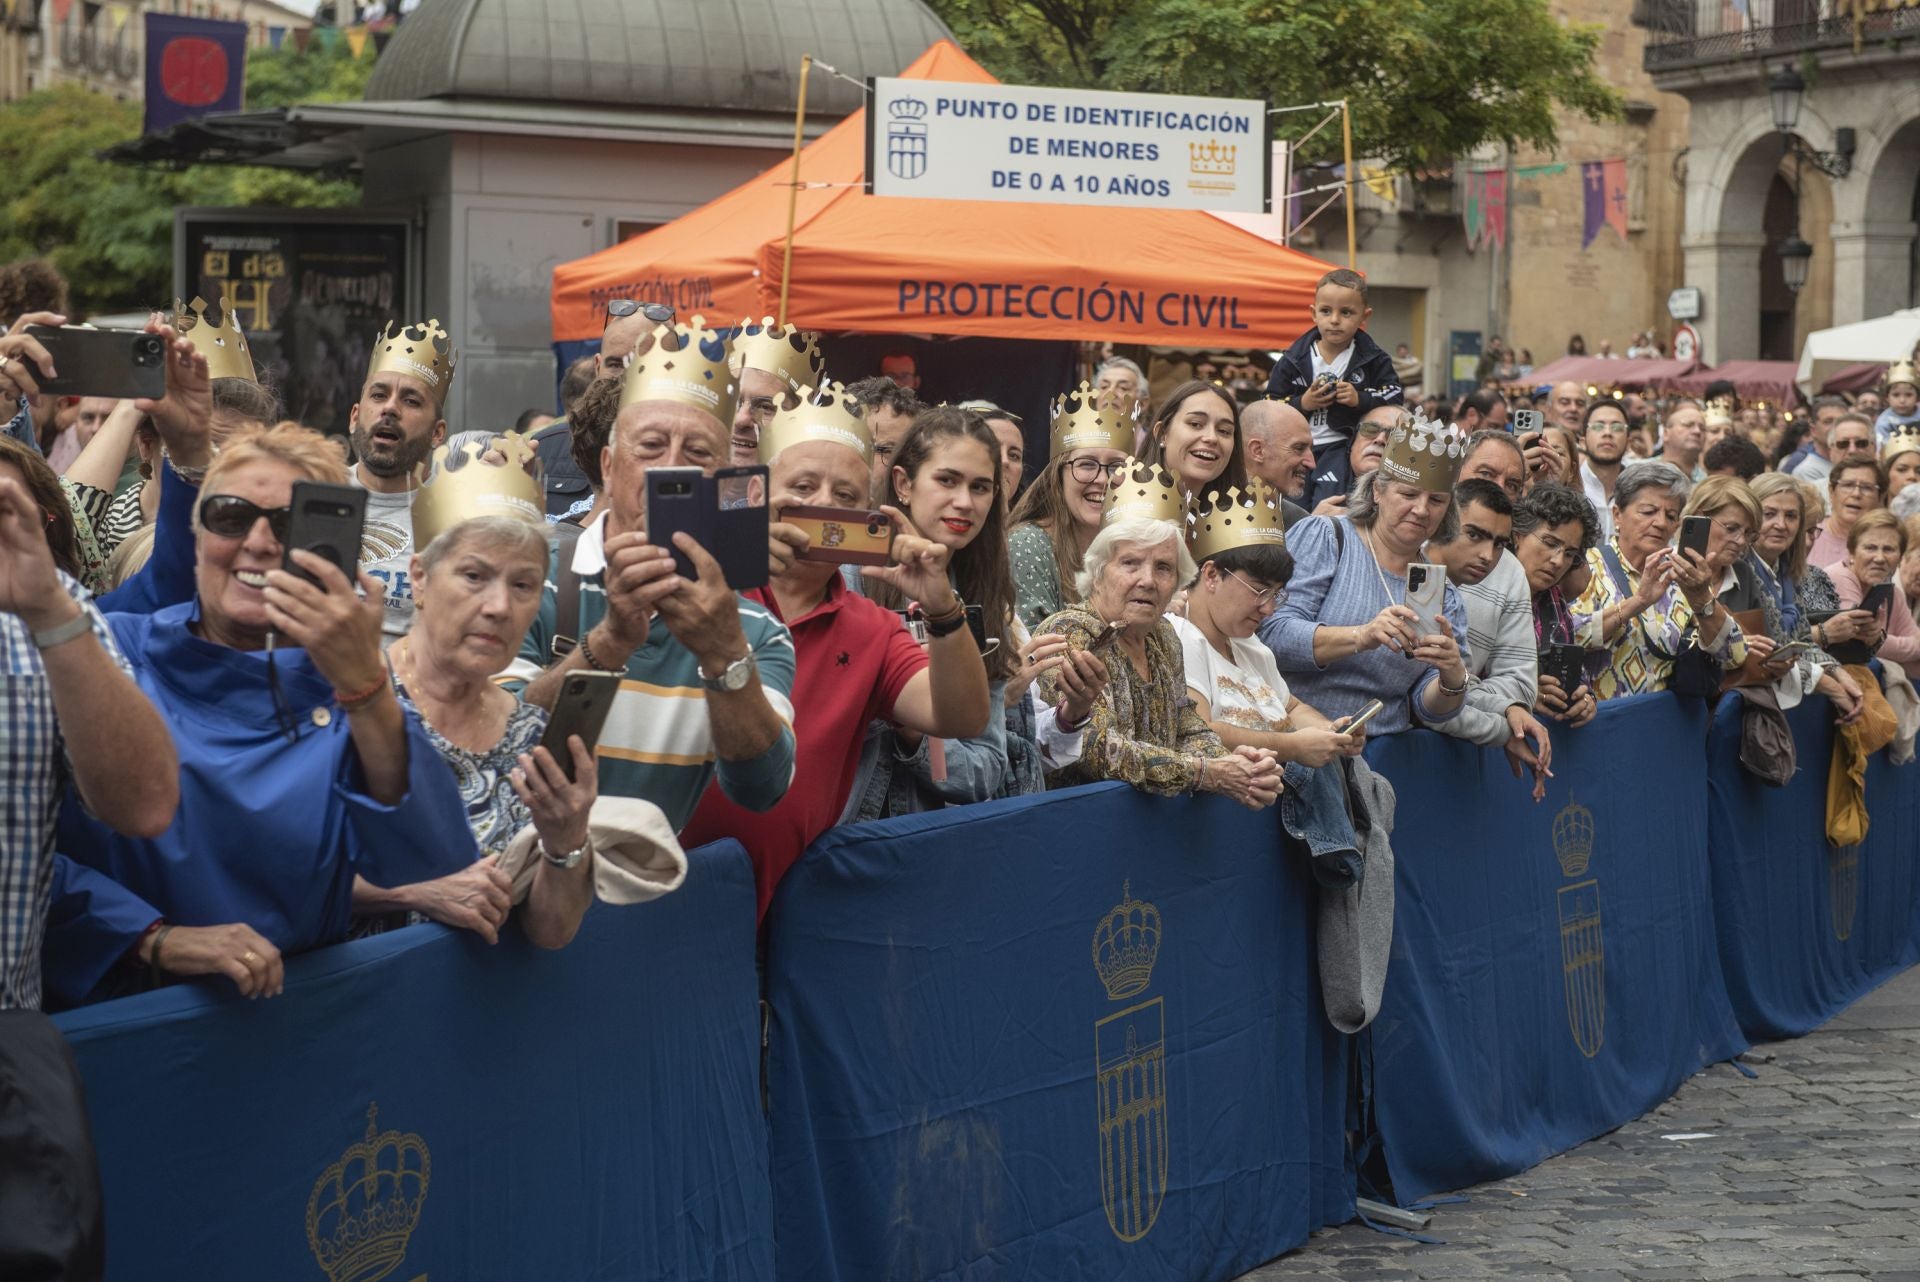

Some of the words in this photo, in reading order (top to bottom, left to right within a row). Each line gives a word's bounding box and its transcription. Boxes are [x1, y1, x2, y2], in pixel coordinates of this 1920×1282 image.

[936, 98, 1018, 120] PUNTO
[1027, 104, 1056, 123] DE
[1064, 106, 1250, 134] IDENTIFICACIÓN
[1009, 136, 1039, 156] DE
[1046, 138, 1160, 162] MENORES
[992, 170, 1021, 189] DE
[1049, 174, 1066, 192] A
[1074, 175, 1100, 194] 10
[1107, 174, 1171, 197] AÑOS
[679, 277, 715, 310] CIVIL
[898, 280, 1145, 325] PROTECCIÓN
[1156, 293, 1249, 330] CIVIL
[1399, 465, 1420, 478] CATÓLICA
